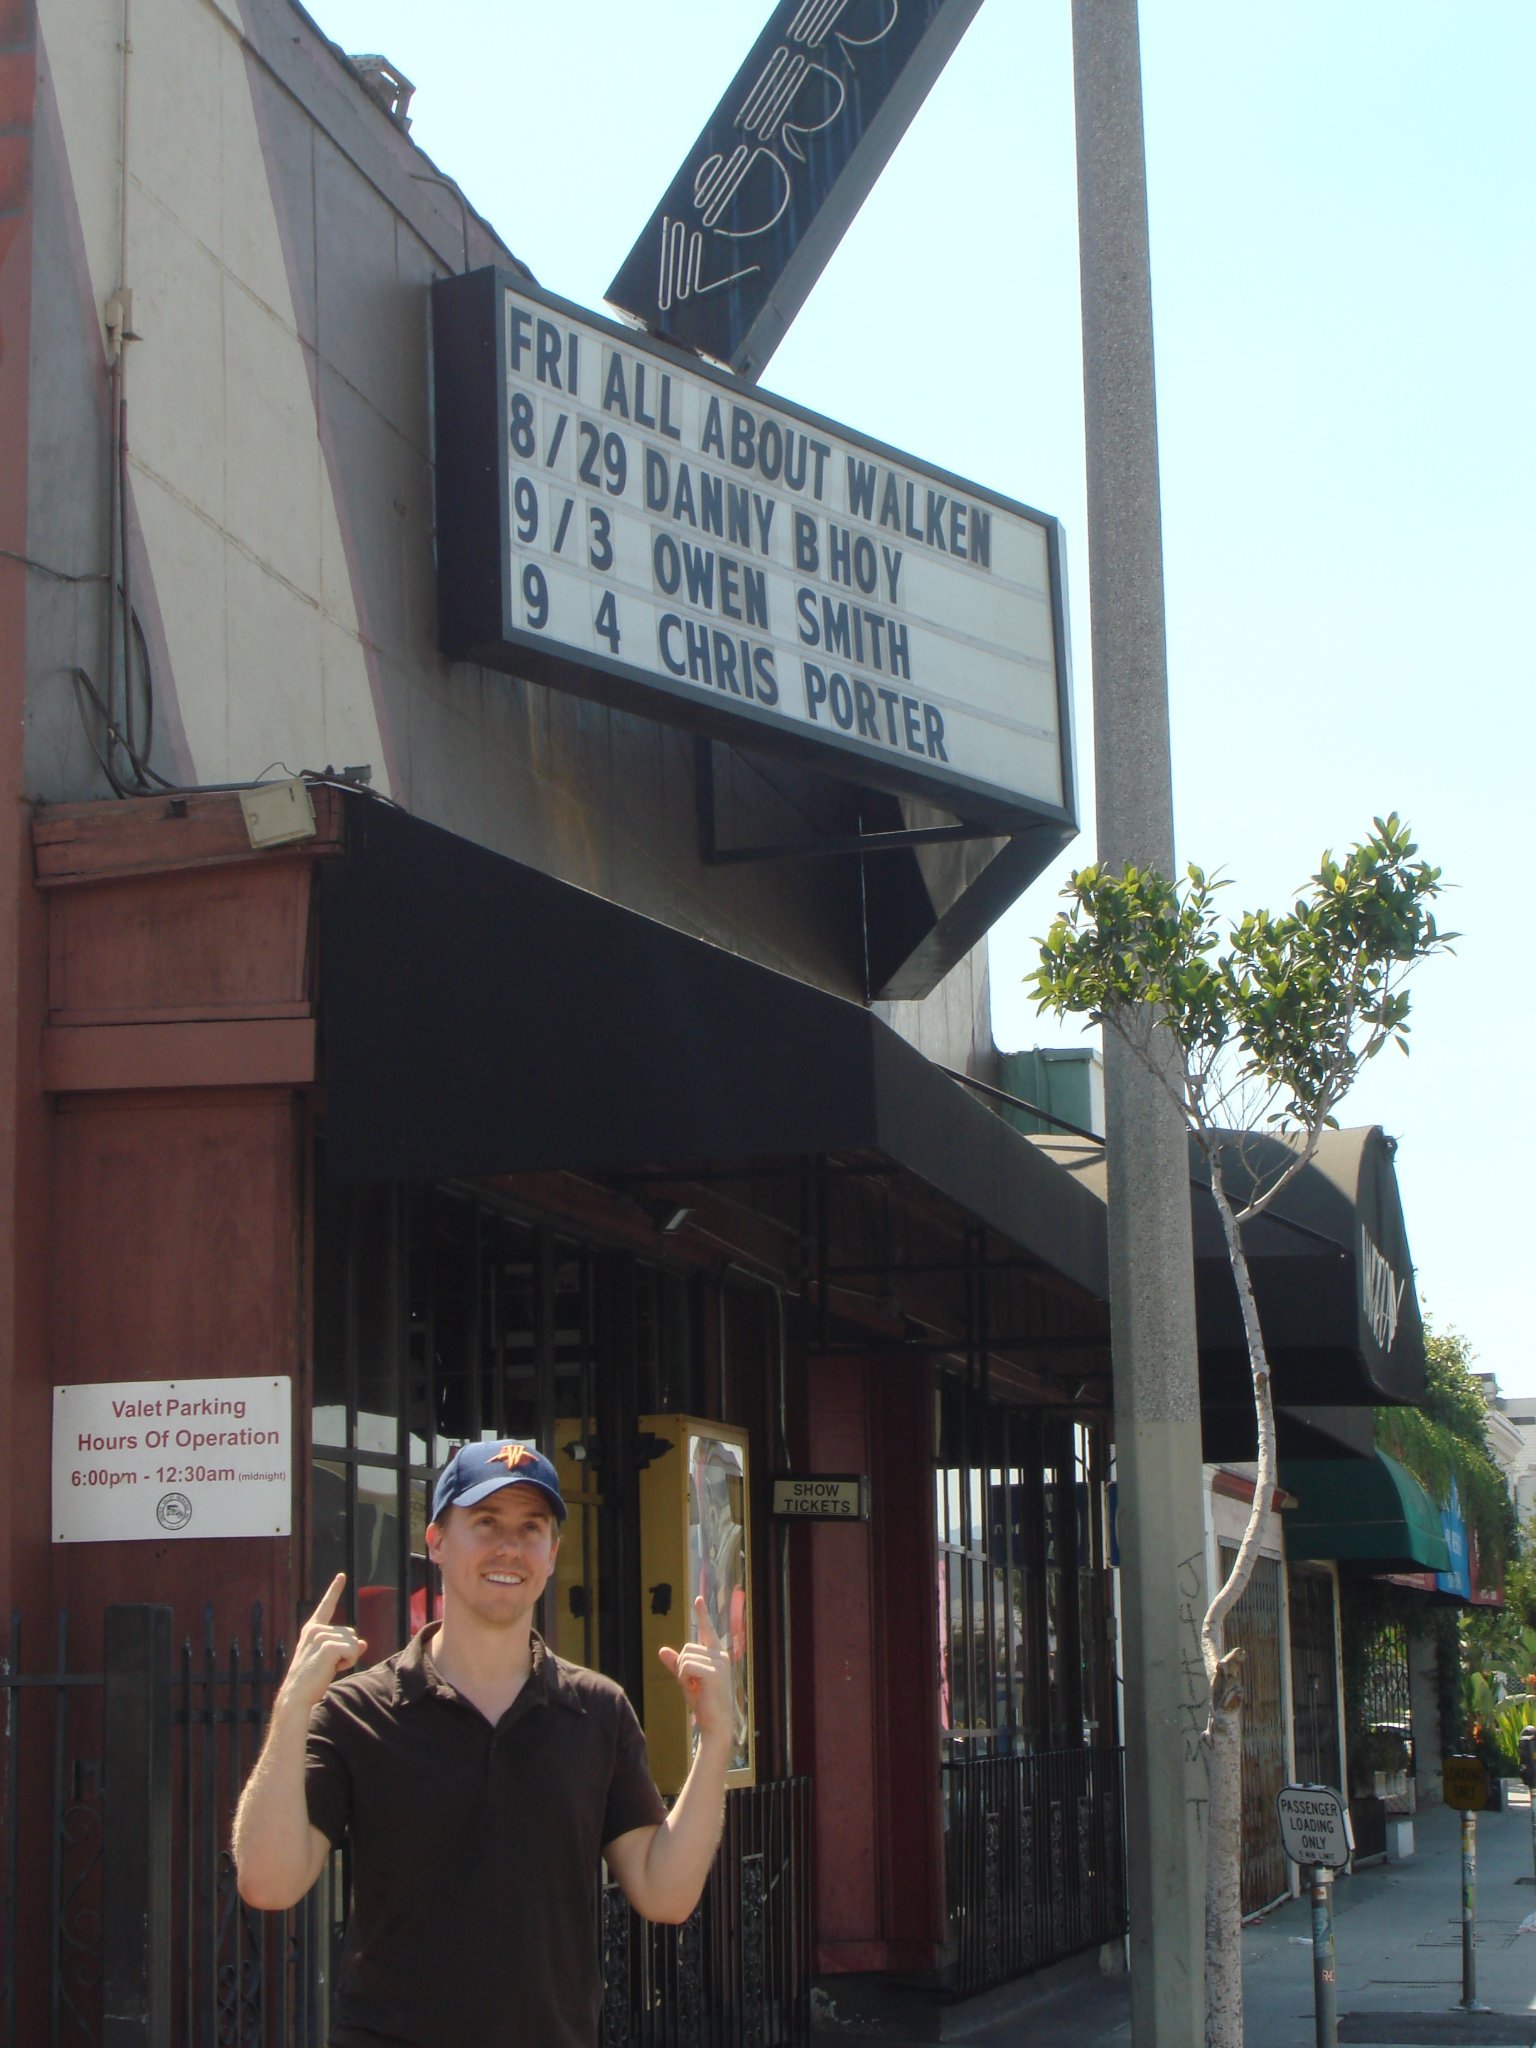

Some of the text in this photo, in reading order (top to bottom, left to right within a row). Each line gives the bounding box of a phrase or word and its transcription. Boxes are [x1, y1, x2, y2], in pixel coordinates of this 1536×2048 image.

[510, 306, 992, 568] FRI ALL ABOUT WALKEN
[509, 392, 904, 604] 8/29 DANNY BHOY
[652, 533, 769, 630] OWEN
[797, 588, 911, 681] SMITH
[522, 562, 950, 763] 9 4 CHRIS PORTER
[111, 1398, 247, 1419] Valet Parking
[77, 1428, 280, 1451] Hours Of Operation
[71, 1469, 137, 1489] 6:00pm
[155, 1466, 236, 1483] 12:30am
[238, 1471, 287, 1483] (midnight)
[793, 1483, 840, 1497] SHOW
[783, 1499, 851, 1513] TICKETS
[1280, 1799, 1338, 1817] PASSENGER
[1290, 1817, 1335, 1834] LOADING
[1301, 1835, 1327, 1850] ONLY
